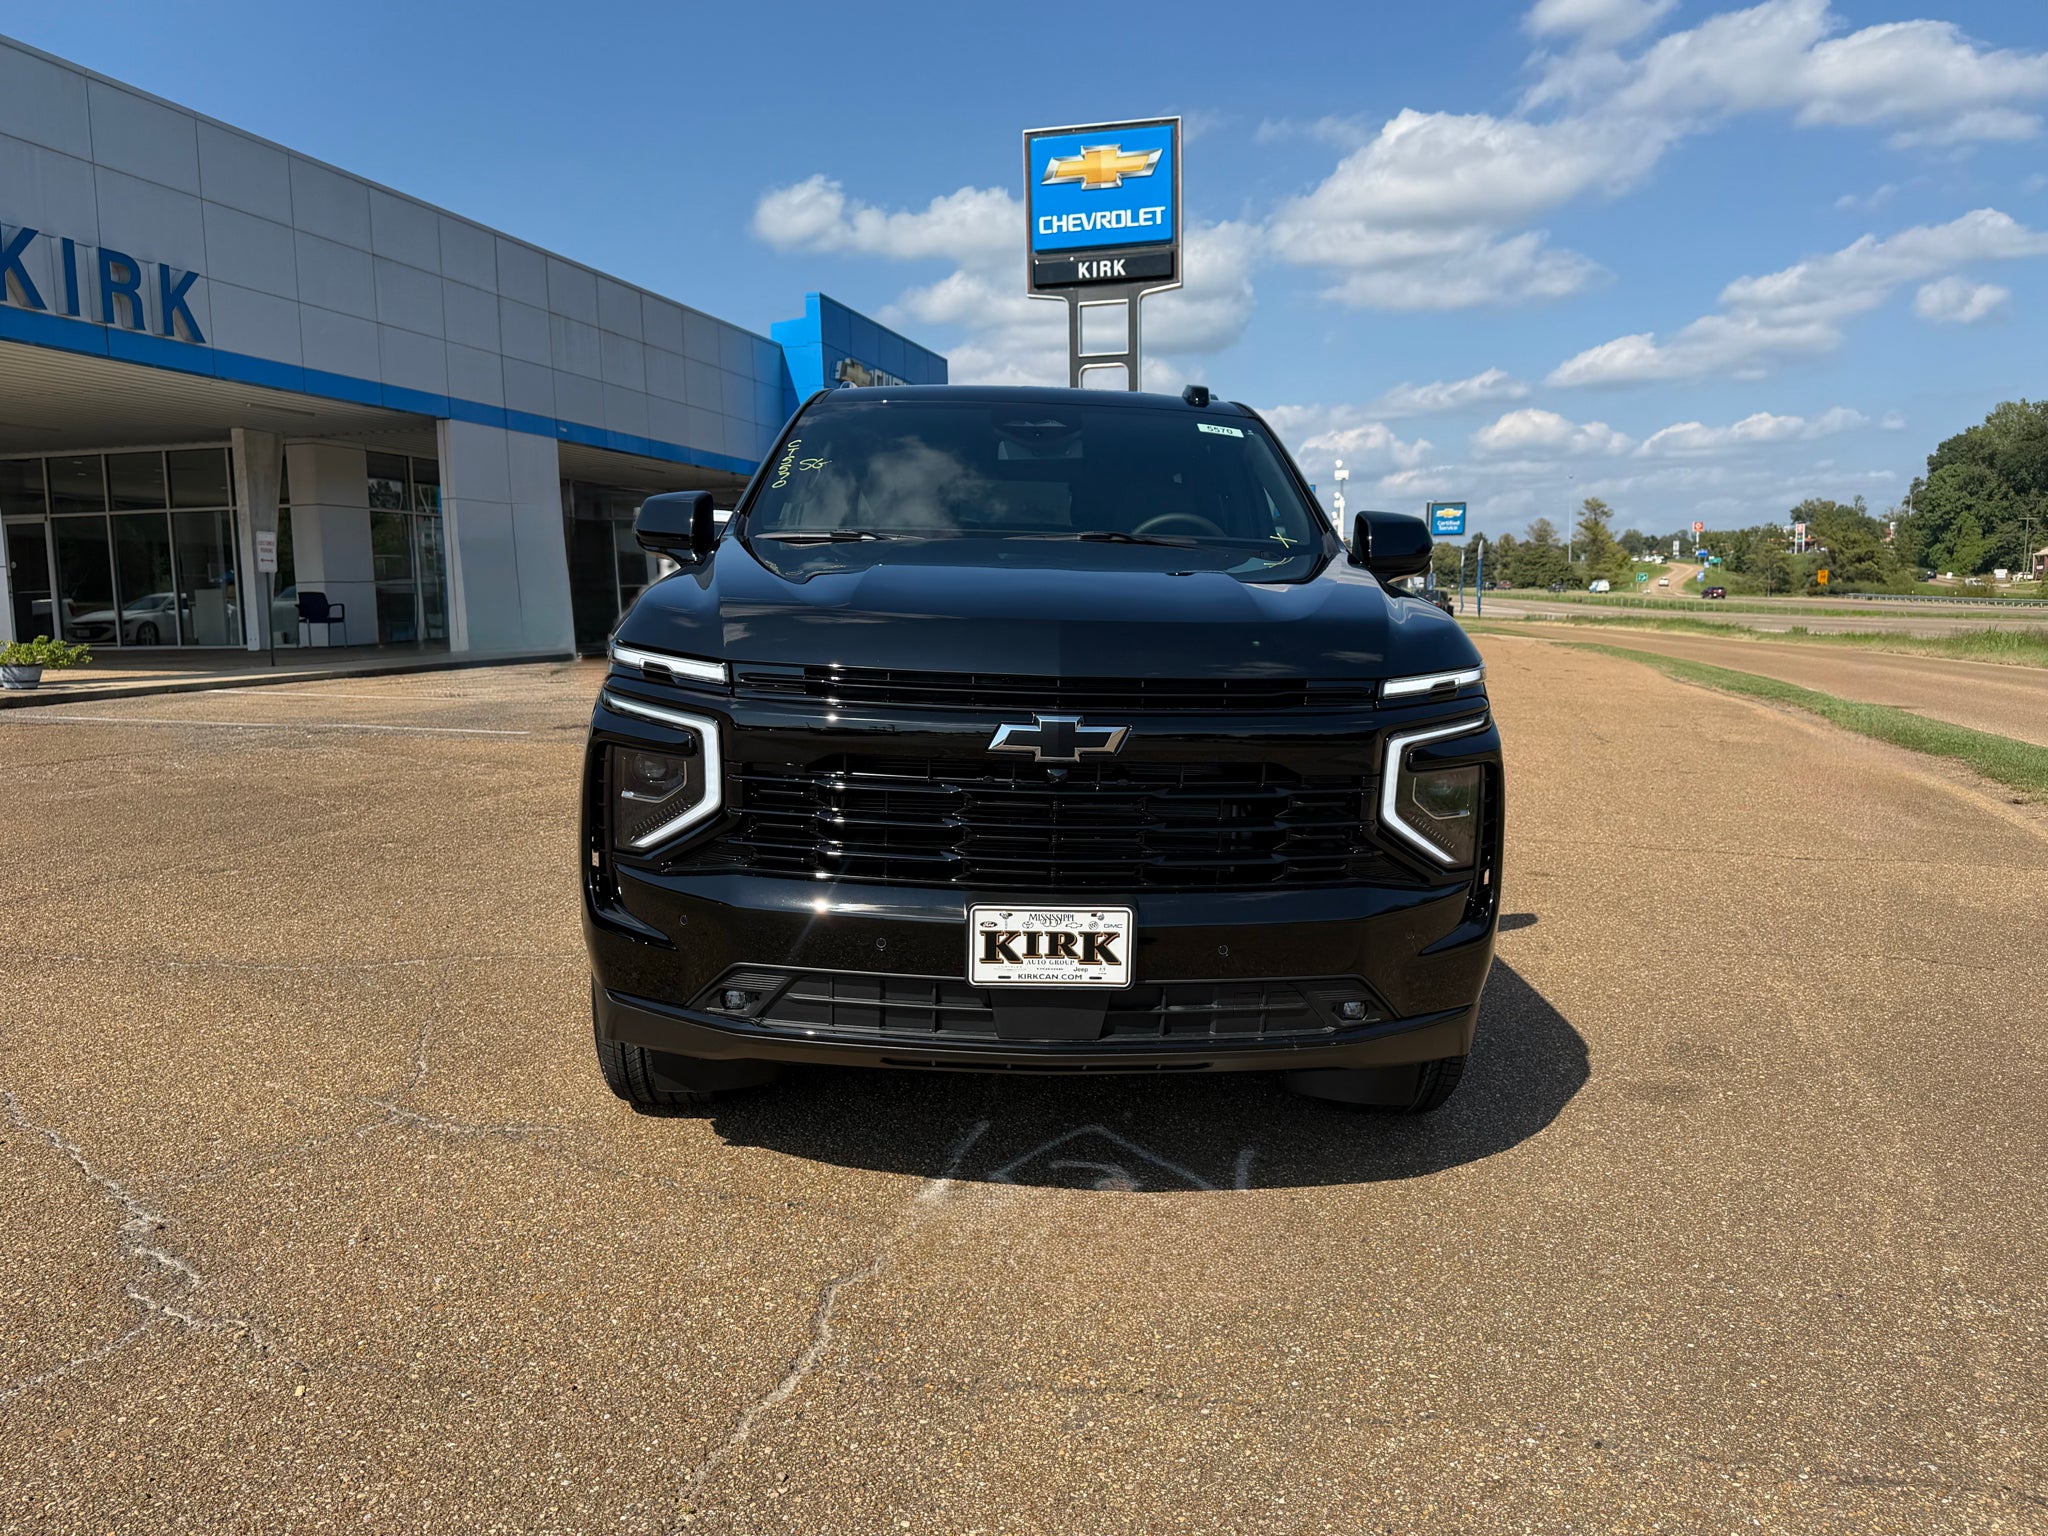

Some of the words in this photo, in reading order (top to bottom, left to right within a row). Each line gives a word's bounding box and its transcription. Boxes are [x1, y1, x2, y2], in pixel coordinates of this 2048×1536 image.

[1038, 206, 1166, 235] CHEVROLET
[0, 220, 206, 344] KIRK
[1078, 258, 1126, 279] KIRK
[1207, 426, 1233, 434] 5570
[979, 930, 1122, 965] KIRK
